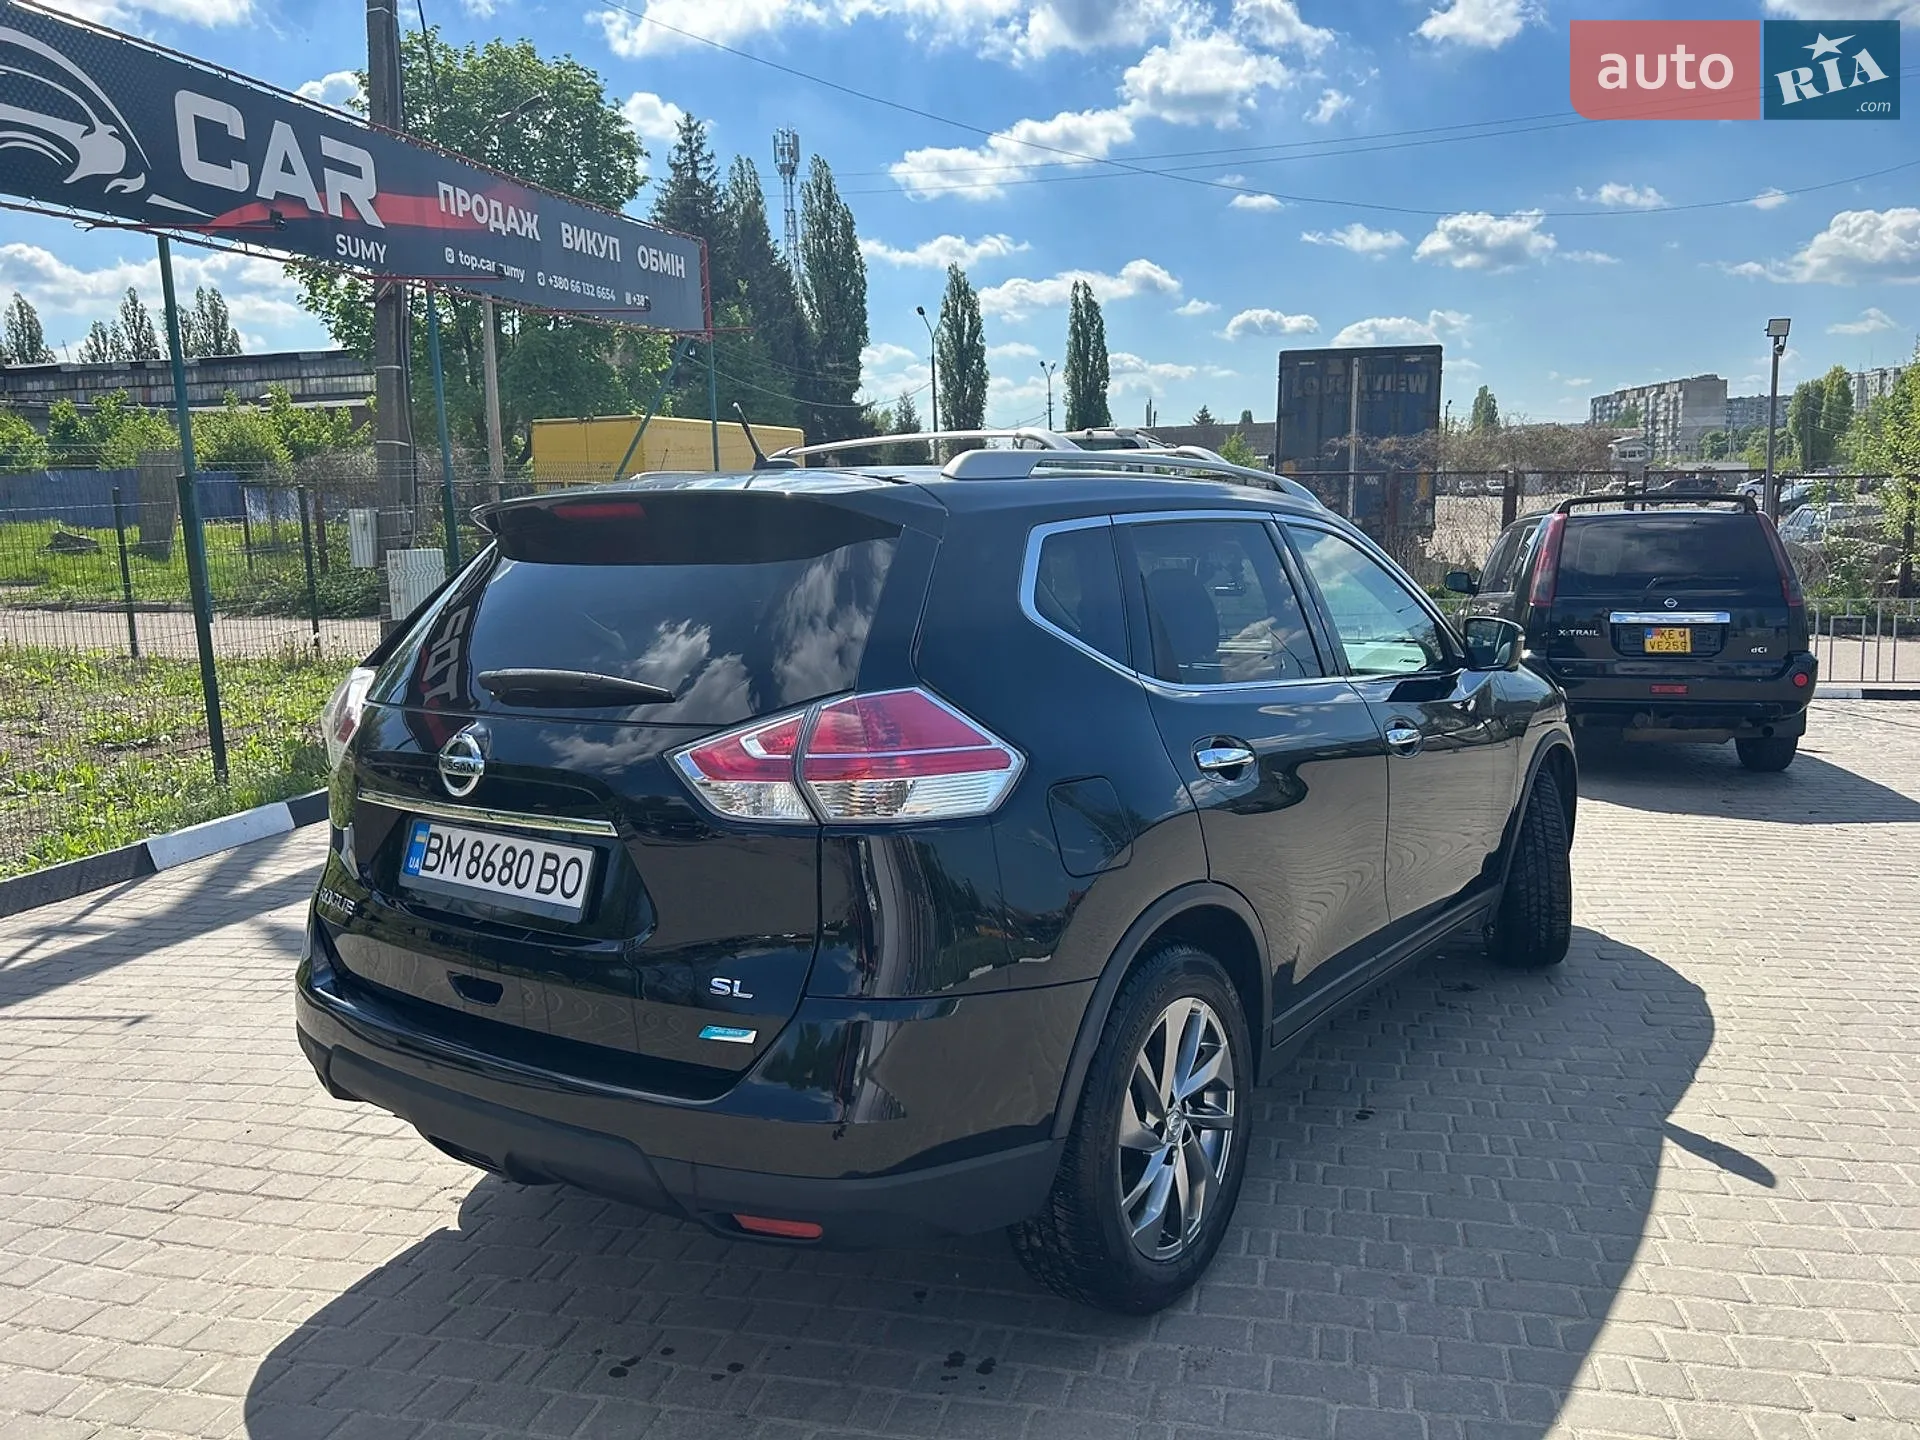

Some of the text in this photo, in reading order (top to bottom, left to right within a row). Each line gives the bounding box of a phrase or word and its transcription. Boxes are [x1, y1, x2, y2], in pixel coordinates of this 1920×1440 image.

[175, 89, 385, 229] CAR
[437, 181, 686, 279] ПРОДАЖ ВИКУП ОБМІН
[336, 233, 387, 264] SUMY
[548, 275, 569, 291] +380
[570, 279, 581, 293] 66
[409, 857, 419, 869] UA
[421, 831, 583, 899] BM 8680 BO
[709, 977, 754, 999] SL
